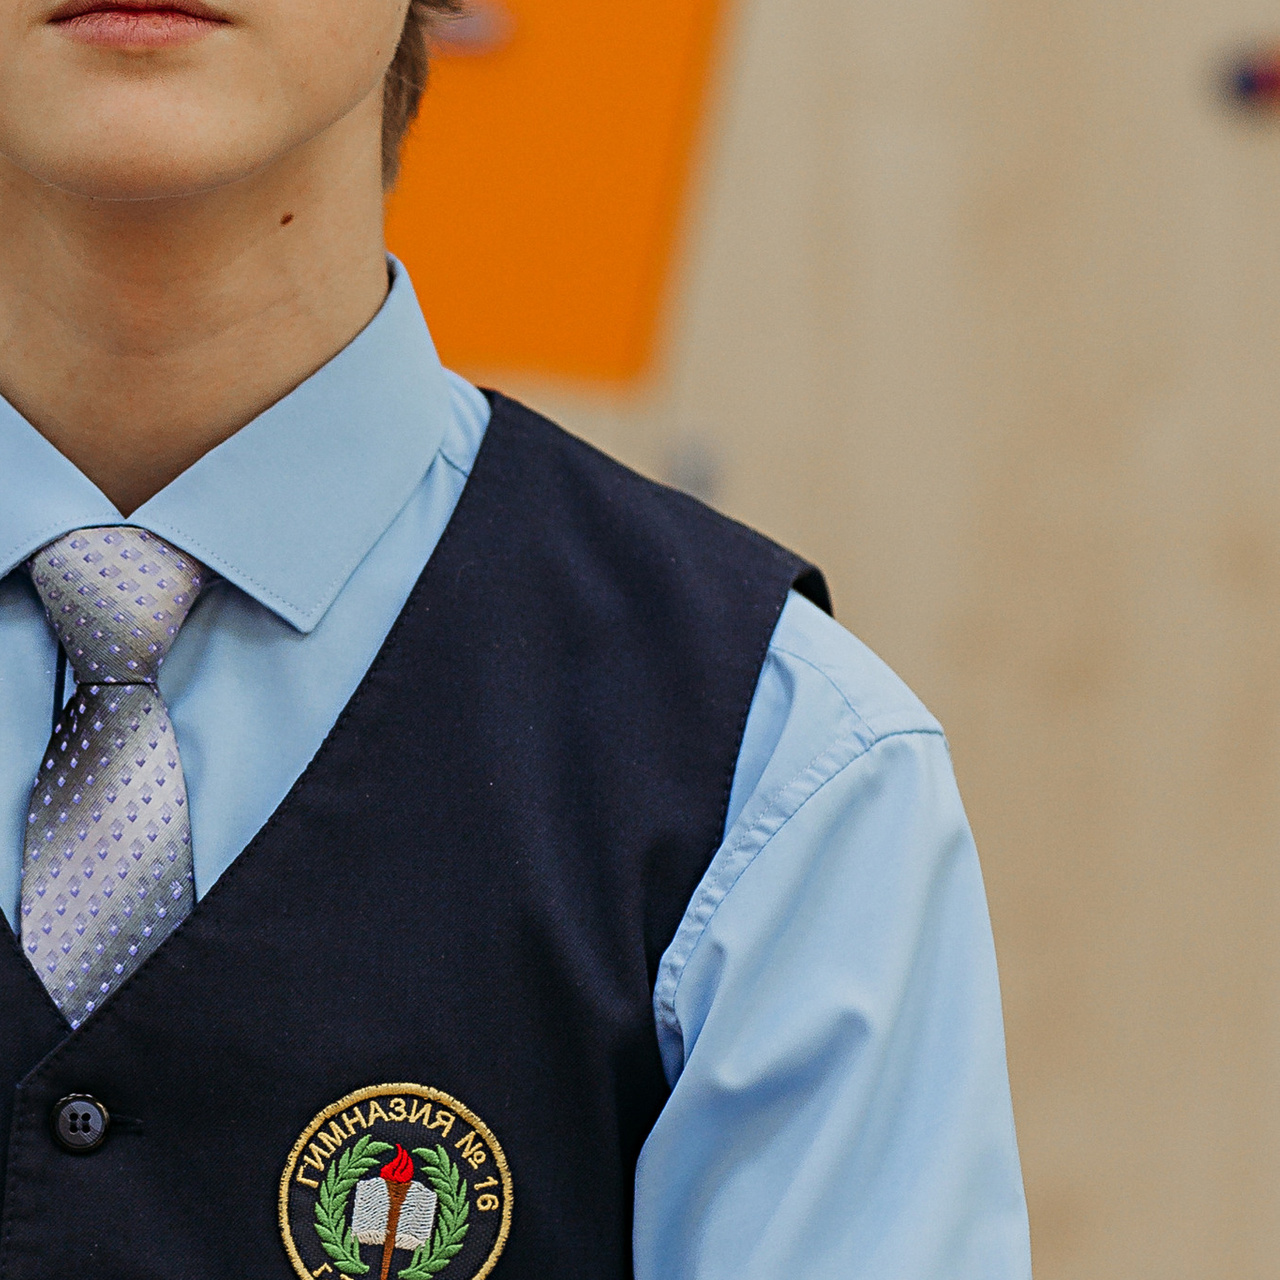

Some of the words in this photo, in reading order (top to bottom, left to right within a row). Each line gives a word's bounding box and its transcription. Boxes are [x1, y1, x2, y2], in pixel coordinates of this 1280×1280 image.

[296, 1098, 455, 1188] ГИМНАЗИЯ
[455, 1131, 486, 1169] №
[474, 1176, 499, 1211] 16
